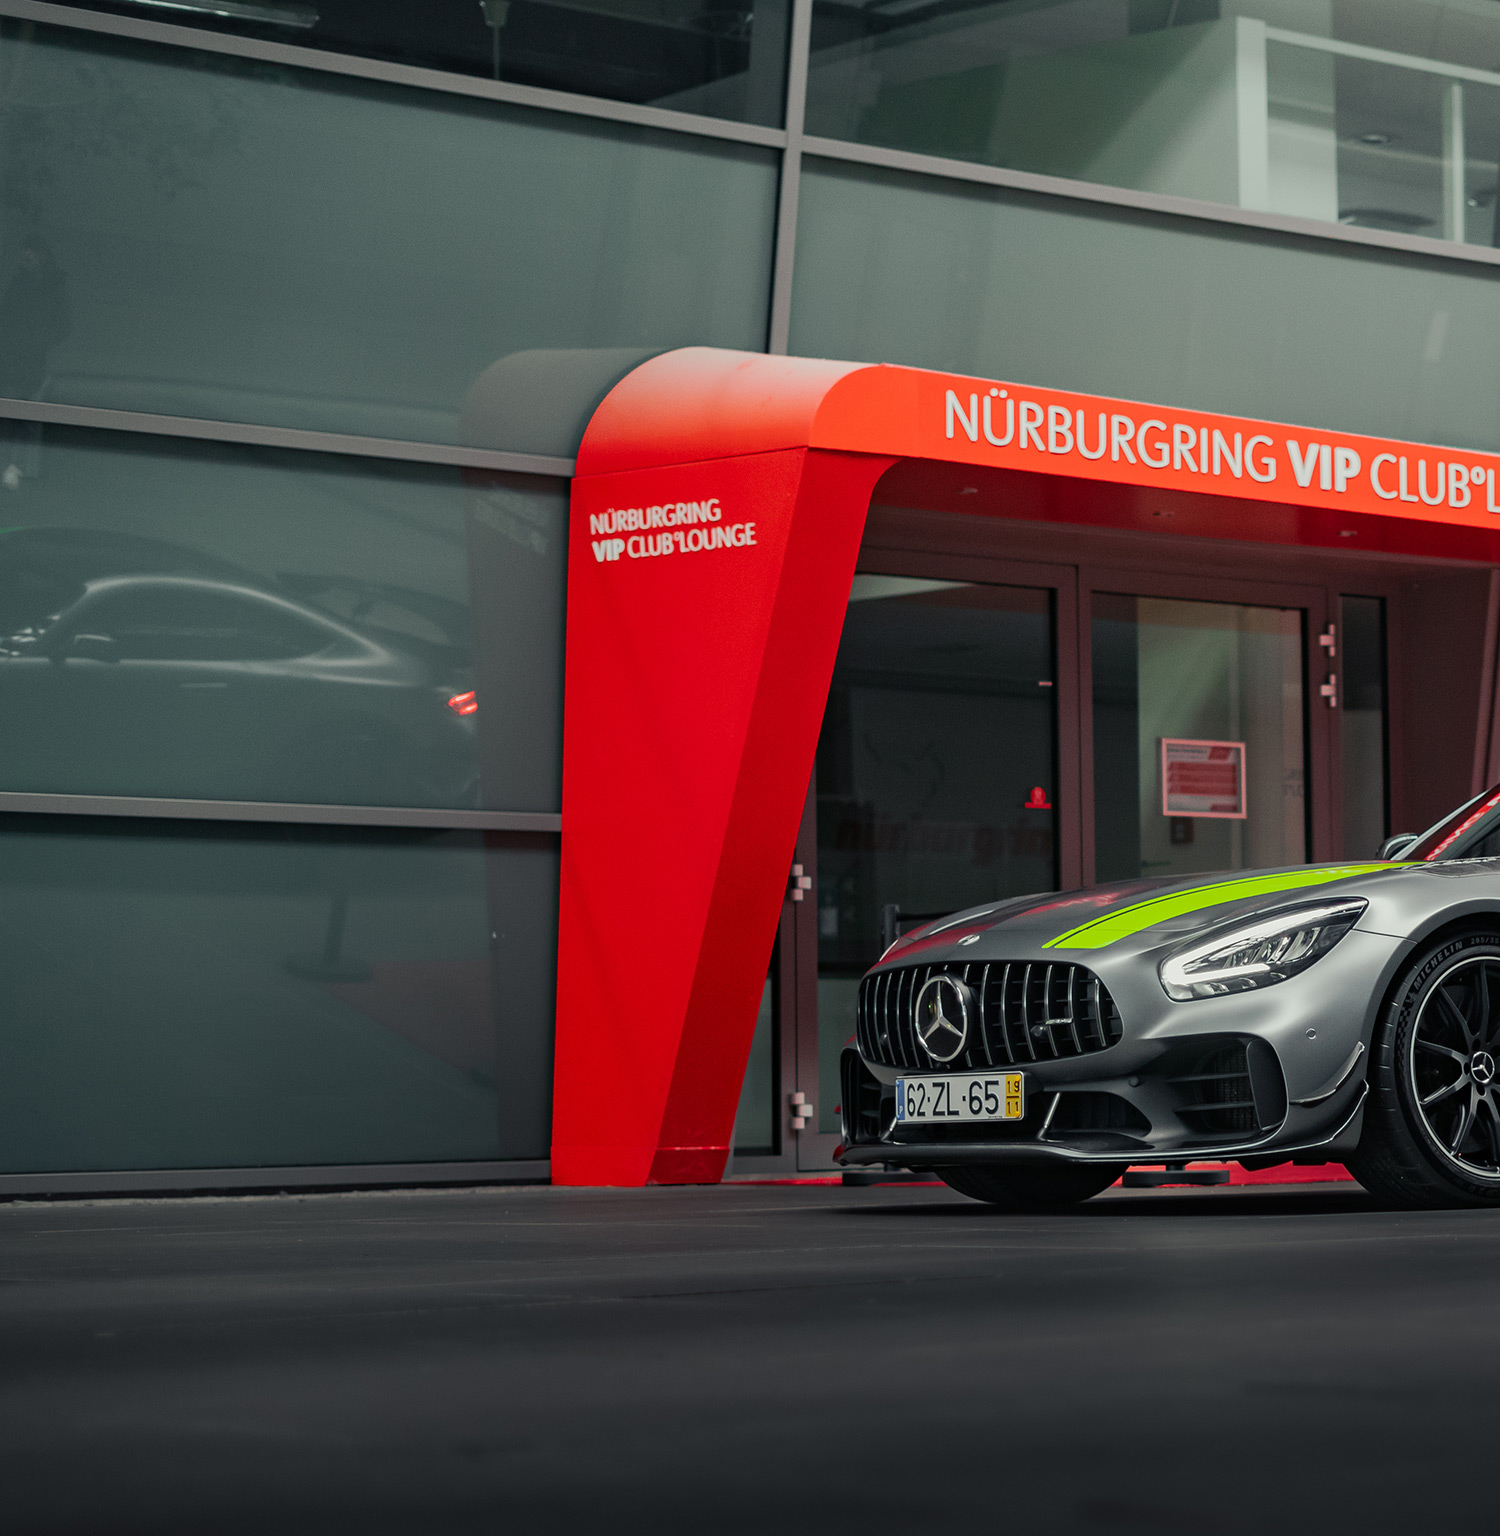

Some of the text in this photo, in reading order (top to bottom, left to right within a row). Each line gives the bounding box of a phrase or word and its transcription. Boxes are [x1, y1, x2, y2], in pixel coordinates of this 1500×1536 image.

[945, 387, 1277, 483] NÜRBURGRING
[1286, 440, 1361, 493] VIP
[589, 498, 722, 536] NÜRBURGRING
[591, 538, 626, 563] VIP
[1413, 941, 1463, 990] MICHELIN
[1007, 1080, 1020, 1093] 19
[1007, 1101, 1019, 1114] 11
